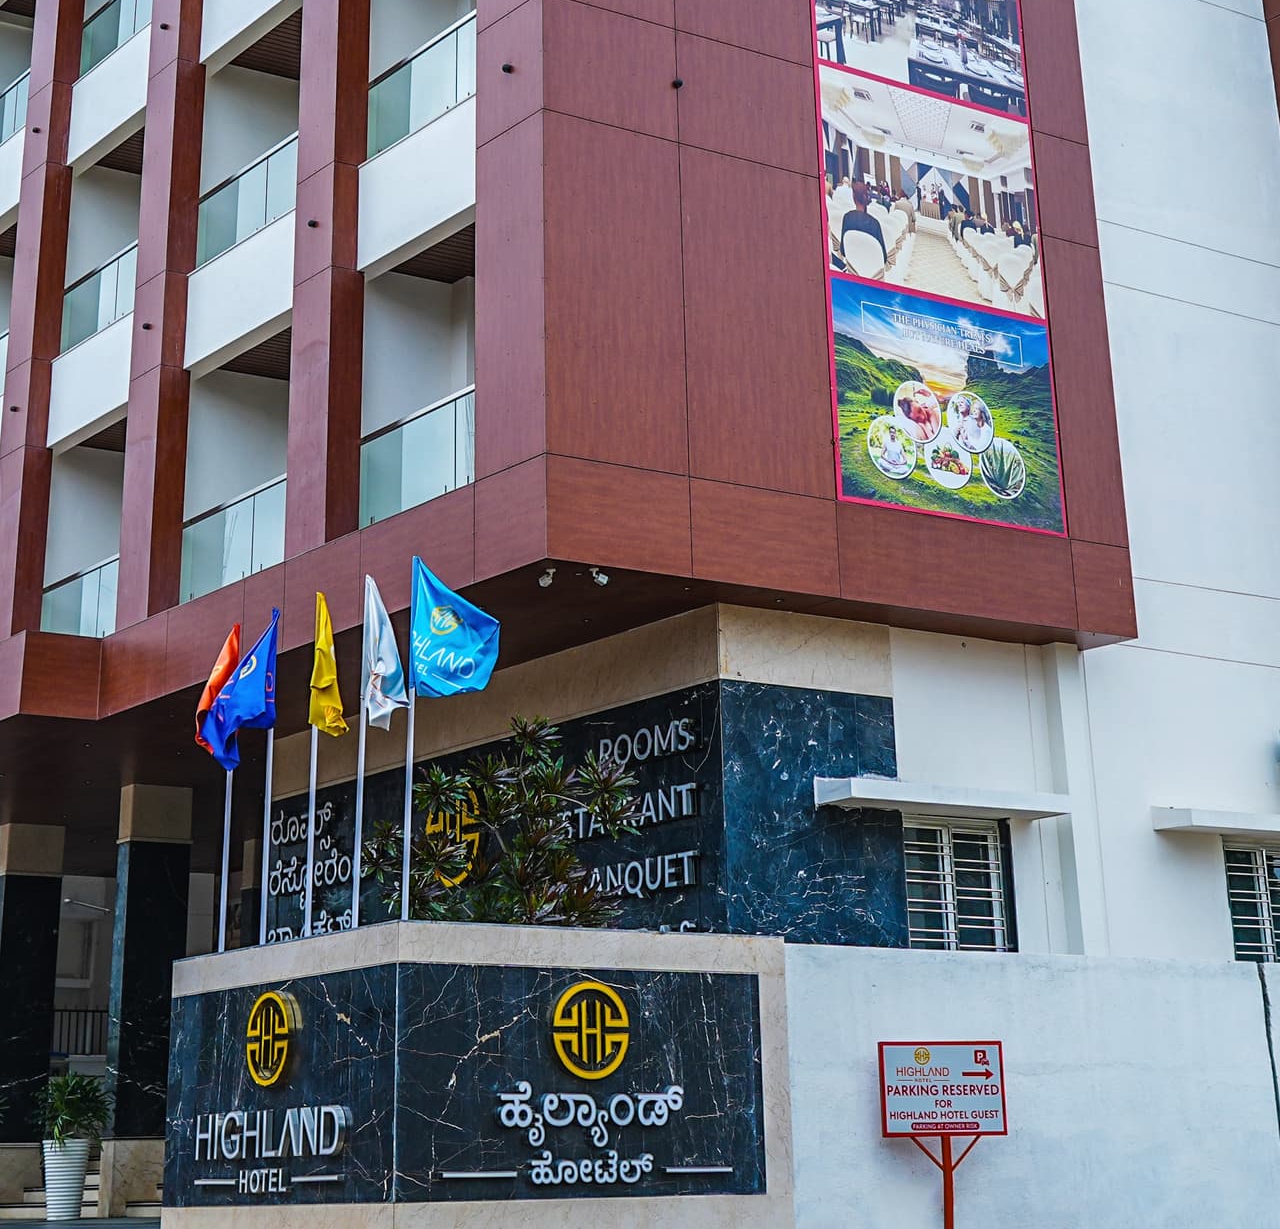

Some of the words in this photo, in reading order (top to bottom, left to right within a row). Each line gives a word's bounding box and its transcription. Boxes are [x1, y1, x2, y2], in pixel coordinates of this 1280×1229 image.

[413, 630, 476, 679] HLAND
[599, 717, 694, 766] ROOMS
[583, 850, 697, 899] ANQUET
[896, 1067, 950, 1077] HIGHLAND
[887, 1084, 939, 1096] PARKING
[942, 1084, 1000, 1096] RESERVED
[889, 1111, 938, 1120] HIGHLAND
[940, 1110, 969, 1120] HOTEL
[970, 1110, 1000, 1119] GUEST
[934, 1099, 953, 1108] FOR
[195, 1105, 348, 1161] HIGHLAND
[238, 1168, 287, 1194] HOTEL
